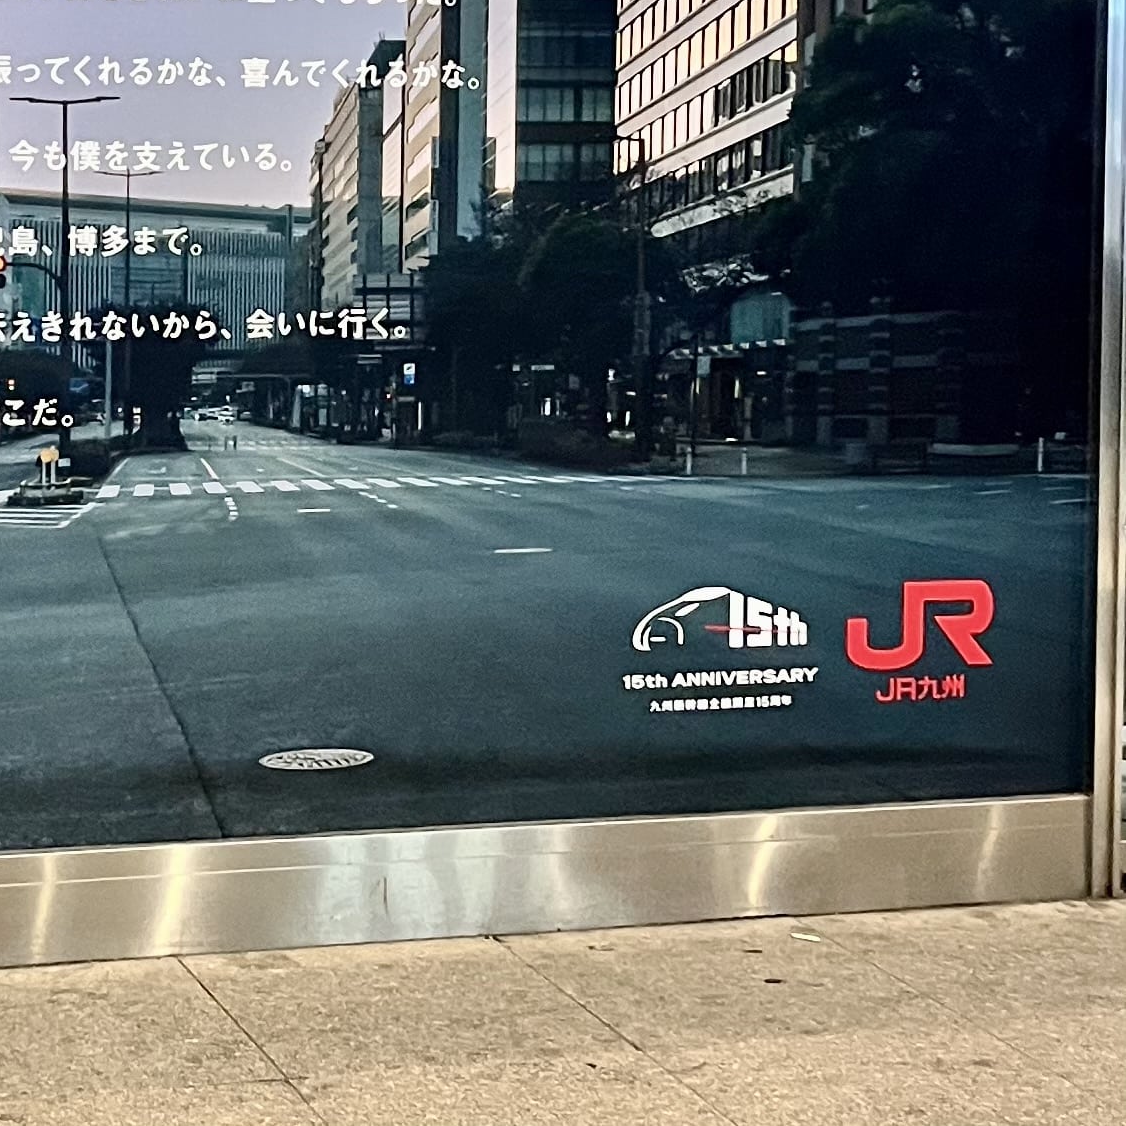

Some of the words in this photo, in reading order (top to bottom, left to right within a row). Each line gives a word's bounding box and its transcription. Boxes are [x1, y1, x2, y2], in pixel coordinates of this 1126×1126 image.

[845, 578, 995, 671] JR
[622, 673, 668, 691] 15th
[671, 666, 819, 689] ANNIVERSARY
[875, 674, 966, 703] JR九州
